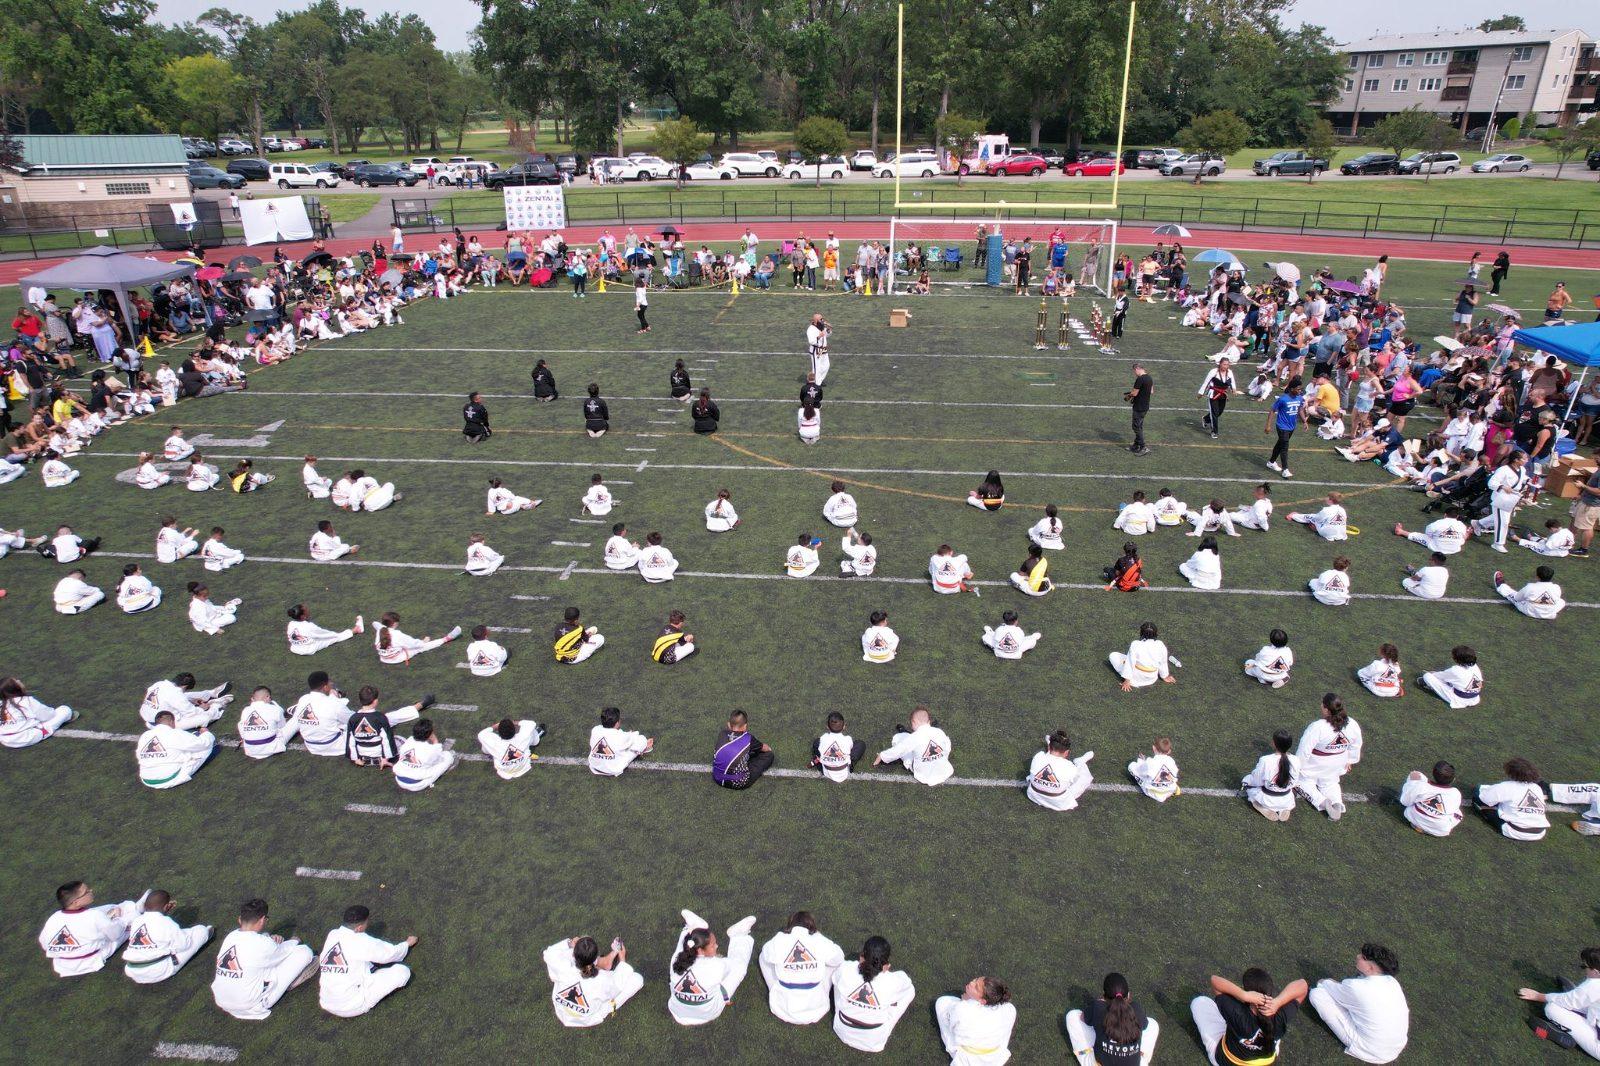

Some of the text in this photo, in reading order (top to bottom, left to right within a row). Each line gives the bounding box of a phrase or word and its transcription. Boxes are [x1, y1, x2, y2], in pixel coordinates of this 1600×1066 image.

[243, 724, 269, 732] ZENTAI
[1033, 778, 1061, 788] ZENTAI
[1567, 785, 1600, 794] ZENTAI
[784, 962, 818, 971] ZENTAI
[216, 968, 243, 979] ENTAI
[674, 992, 708, 1002] ZENTAI
[555, 996, 590, 1014] ZENTAI
